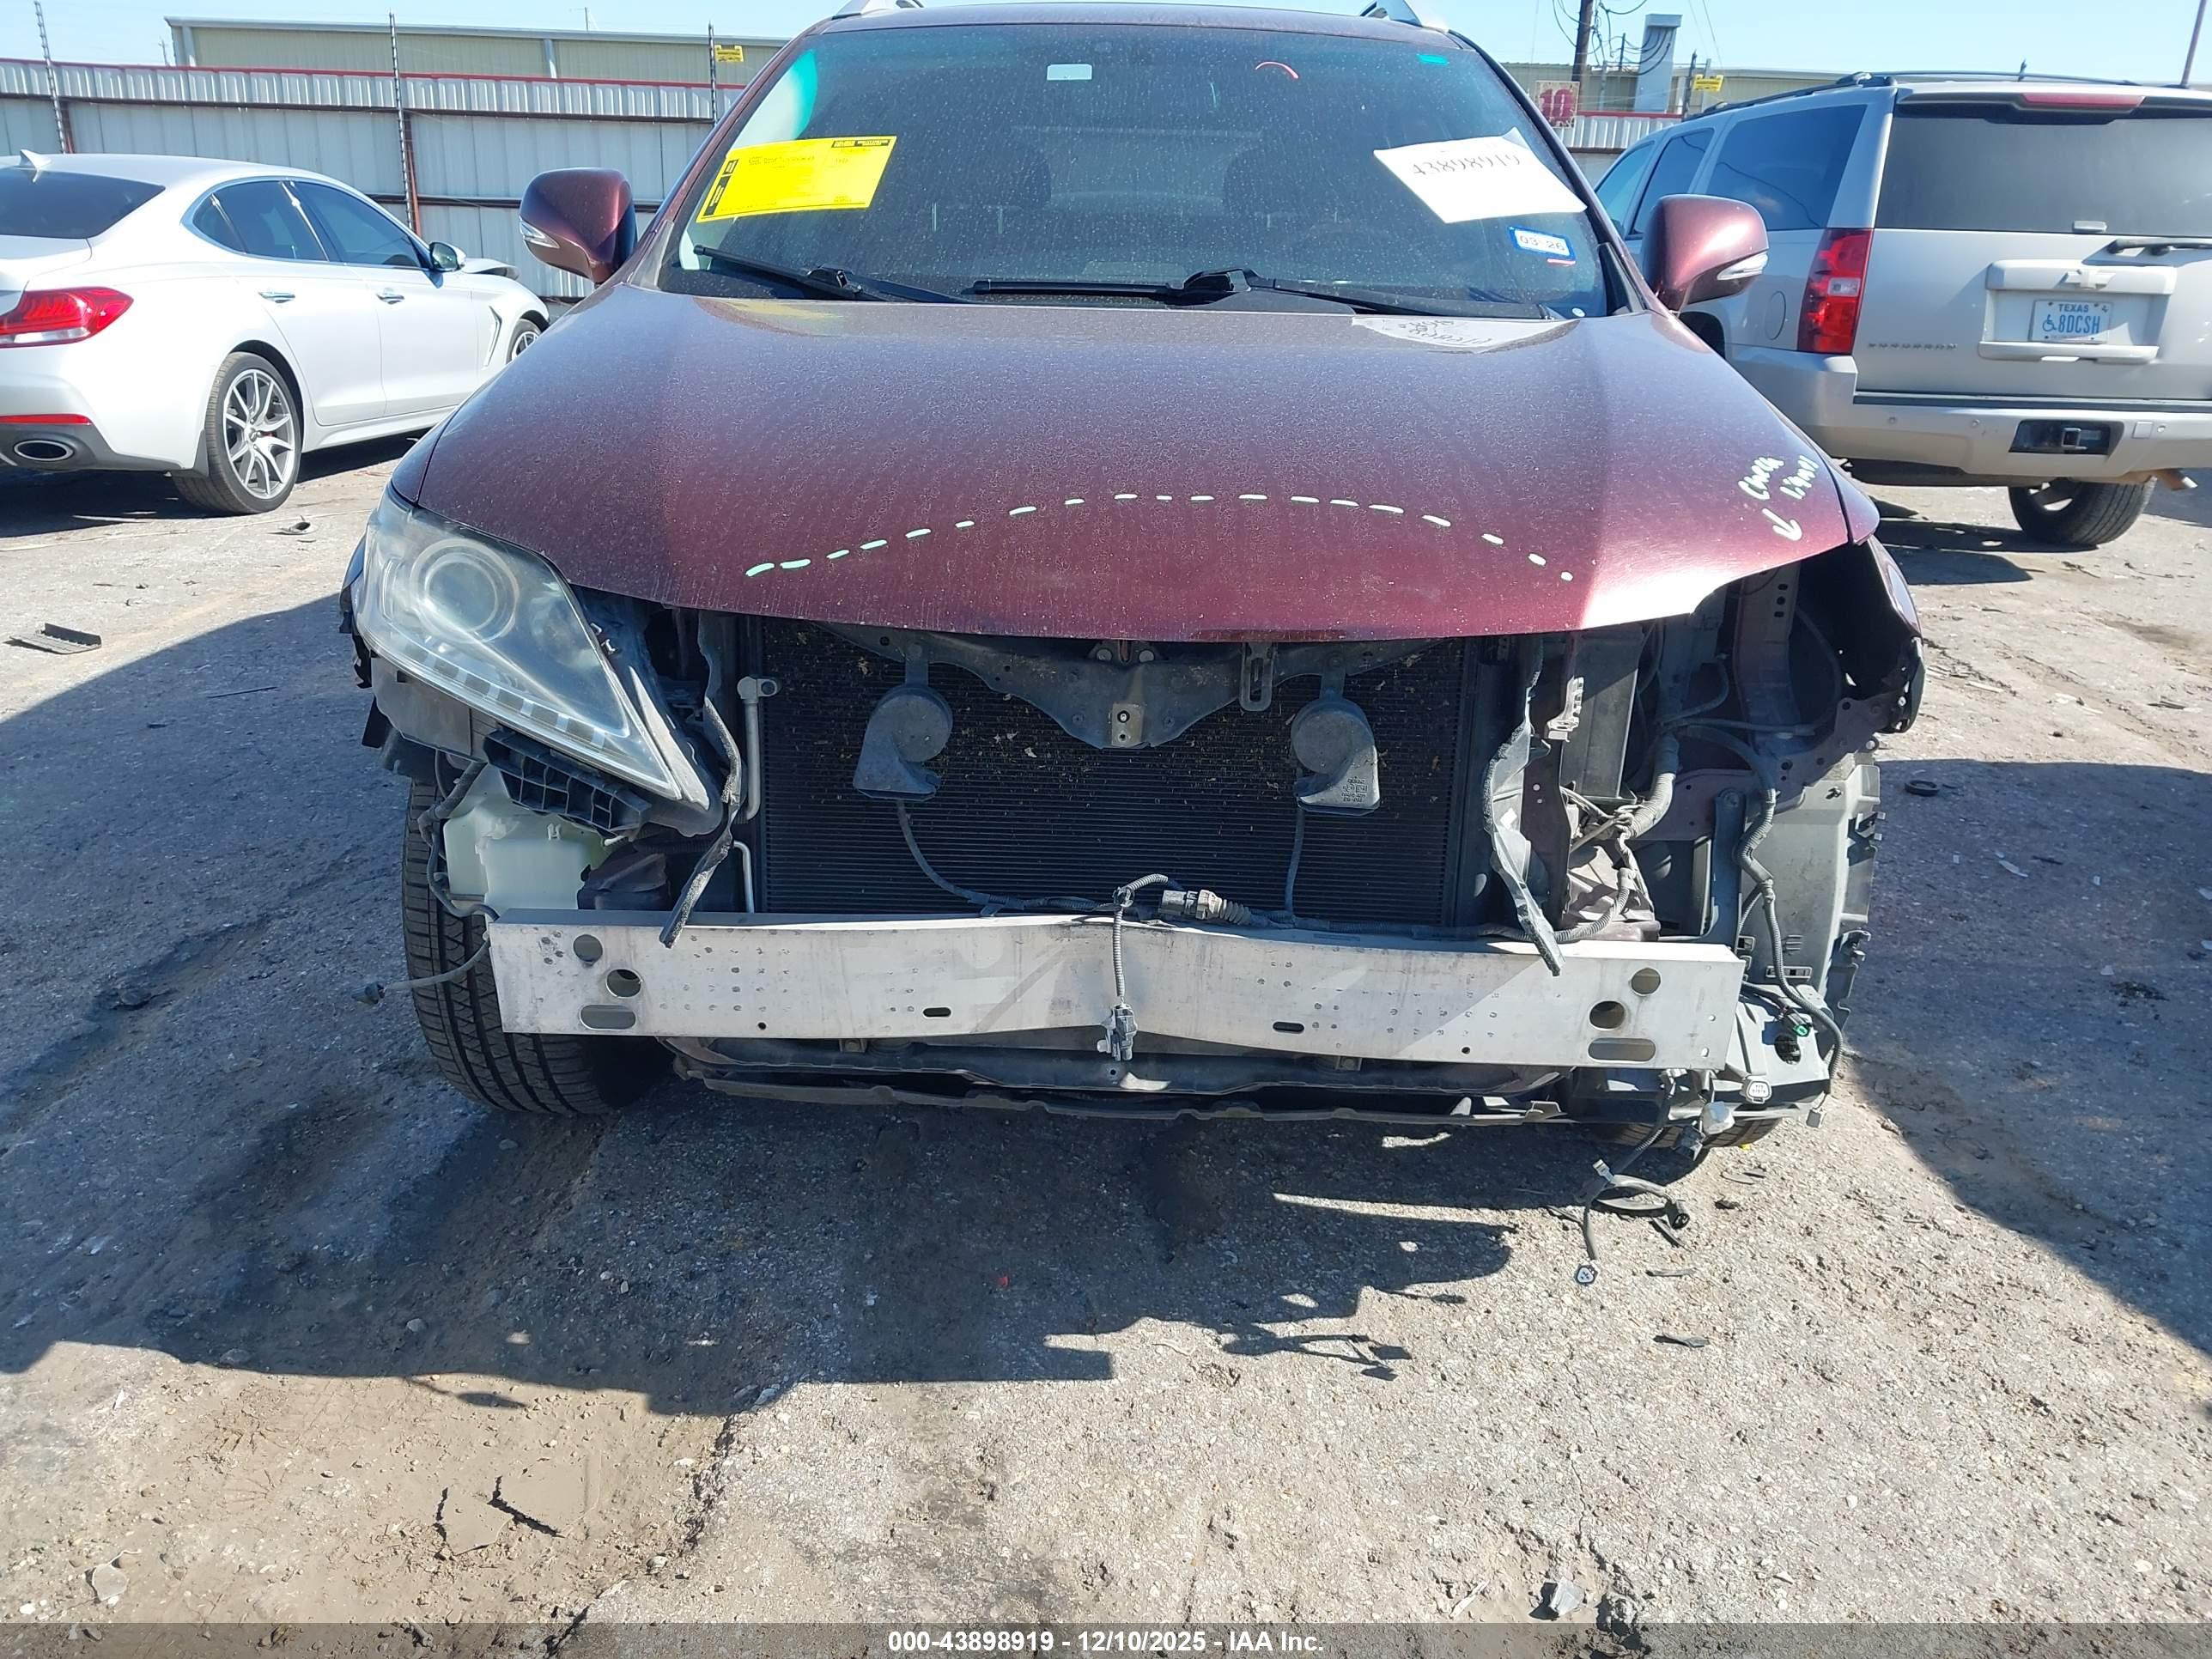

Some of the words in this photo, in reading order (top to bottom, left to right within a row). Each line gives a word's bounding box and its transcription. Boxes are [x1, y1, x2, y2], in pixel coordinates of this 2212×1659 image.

[1413, 154, 1521, 175] 43898919
[2059, 304, 2089, 313] TEXAS
[2058, 315, 2100, 333] 8DCSH
